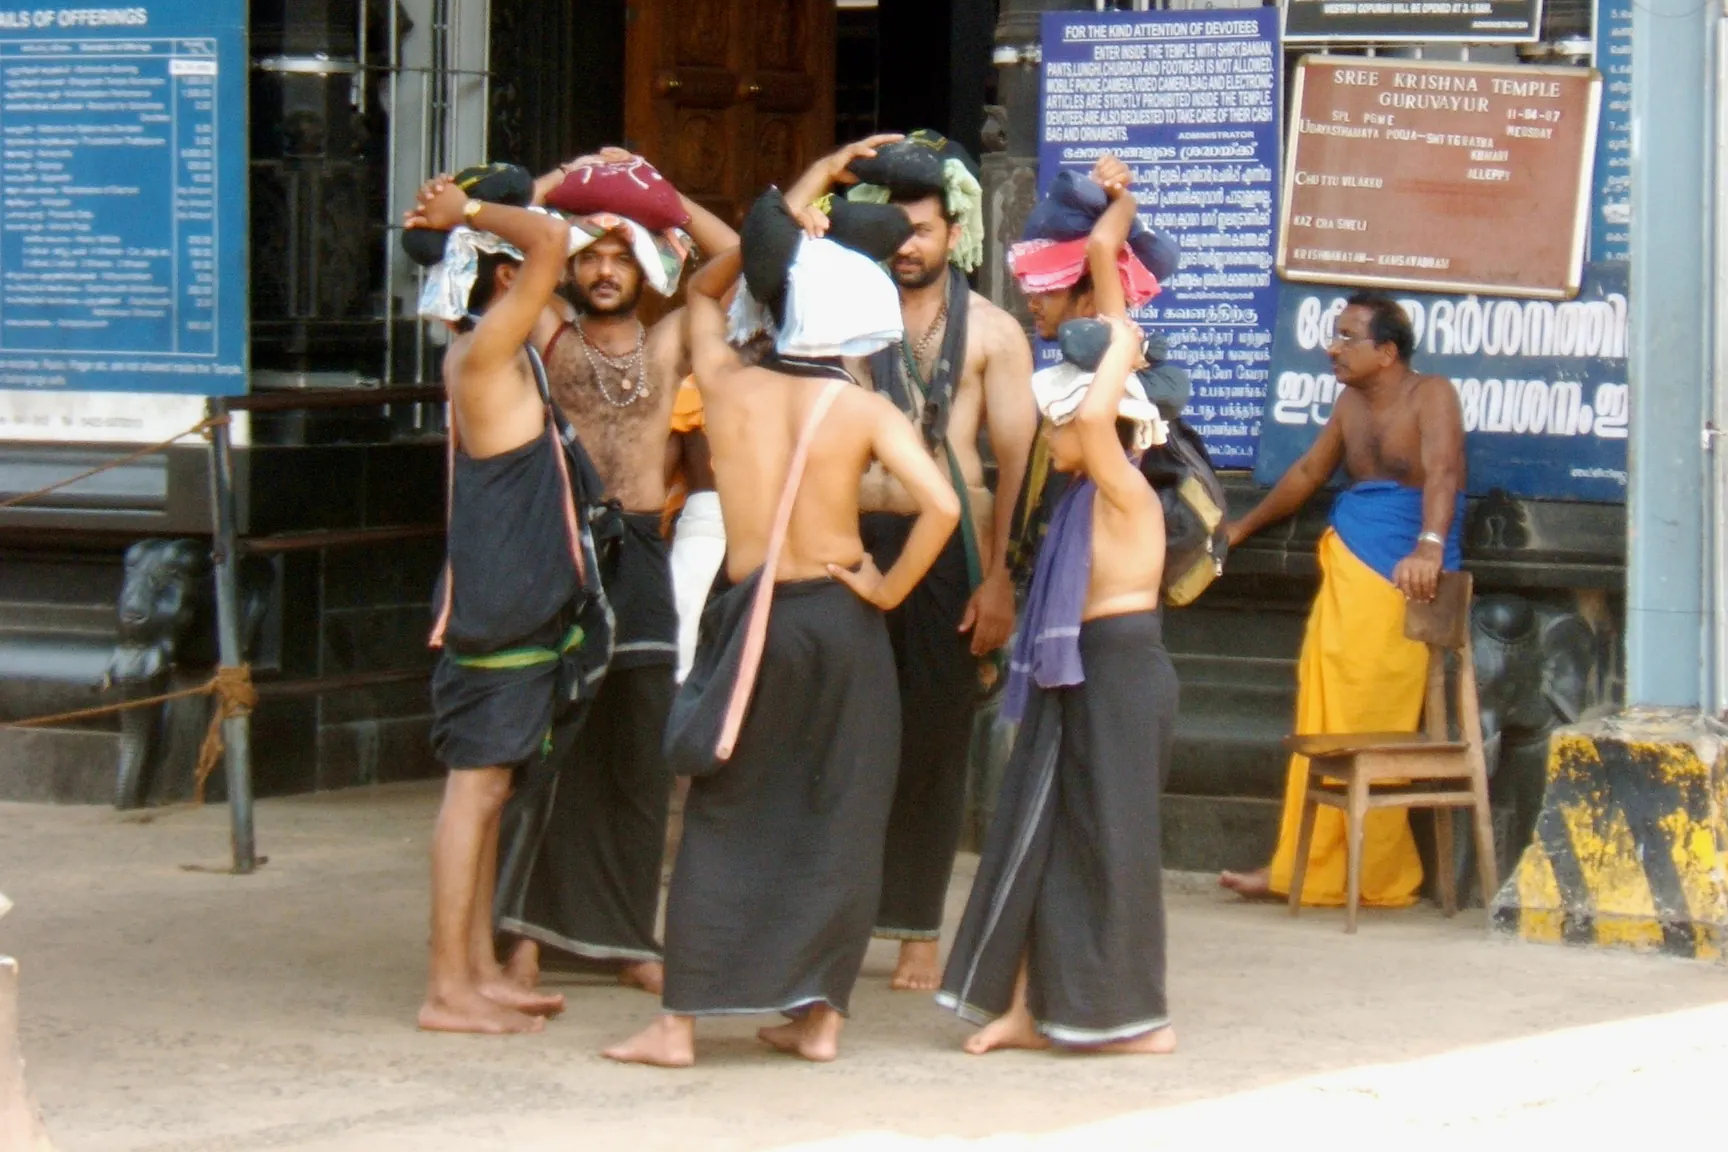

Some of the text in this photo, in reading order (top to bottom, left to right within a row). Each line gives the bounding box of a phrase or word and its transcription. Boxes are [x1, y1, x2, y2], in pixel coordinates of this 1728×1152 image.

[32, 10, 56, 28] OF
[57, 7, 148, 27] OFFERINGS
[1066, 20, 1258, 38] FOR THE KIND ATTENTION OF DEVOTEES
[1095, 45, 1120, 60] ENTER
[1121, 44, 1147, 59] INSIDE
[1148, 44, 1163, 59] THE
[1165, 43, 1195, 58] TEMPLE
[1197, 42, 1216, 58] WITH
[1143, 60, 1160, 75] AND
[1162, 59, 1206, 74] FOOTWEAR
[1207, 59, 1214, 73] IS
[1216, 58, 1231, 73] NOT
[1047, 78, 1074, 93] MOBILE
[1208, 75, 1224, 90] AND
[1226, 74, 1273, 89] ELECTRONIC
[1334, 70, 1560, 97] SREE KRISHNA TEMPLE
[1047, 94, 1084, 109] ARTICLES
[1086, 94, 1102, 108] ARE
[1104, 93, 1140, 108] STRICTLY
[1142, 92, 1190, 107] PROHIBITED
[1192, 92, 1218, 106] INSIDE
[1220, 91, 1237, 106] THE
[1379, 92, 1488, 112] GURUVAYUR
[1046, 107, 1272, 126] DEVOTEES ARE ALSO REQUESTED TO TAKE CARE OF THEIR CASH
[1045, 127, 1062, 142] BAG
[1064, 127, 1078, 141] AND
[1178, 131, 1254, 139] ADMINISTRATOR
